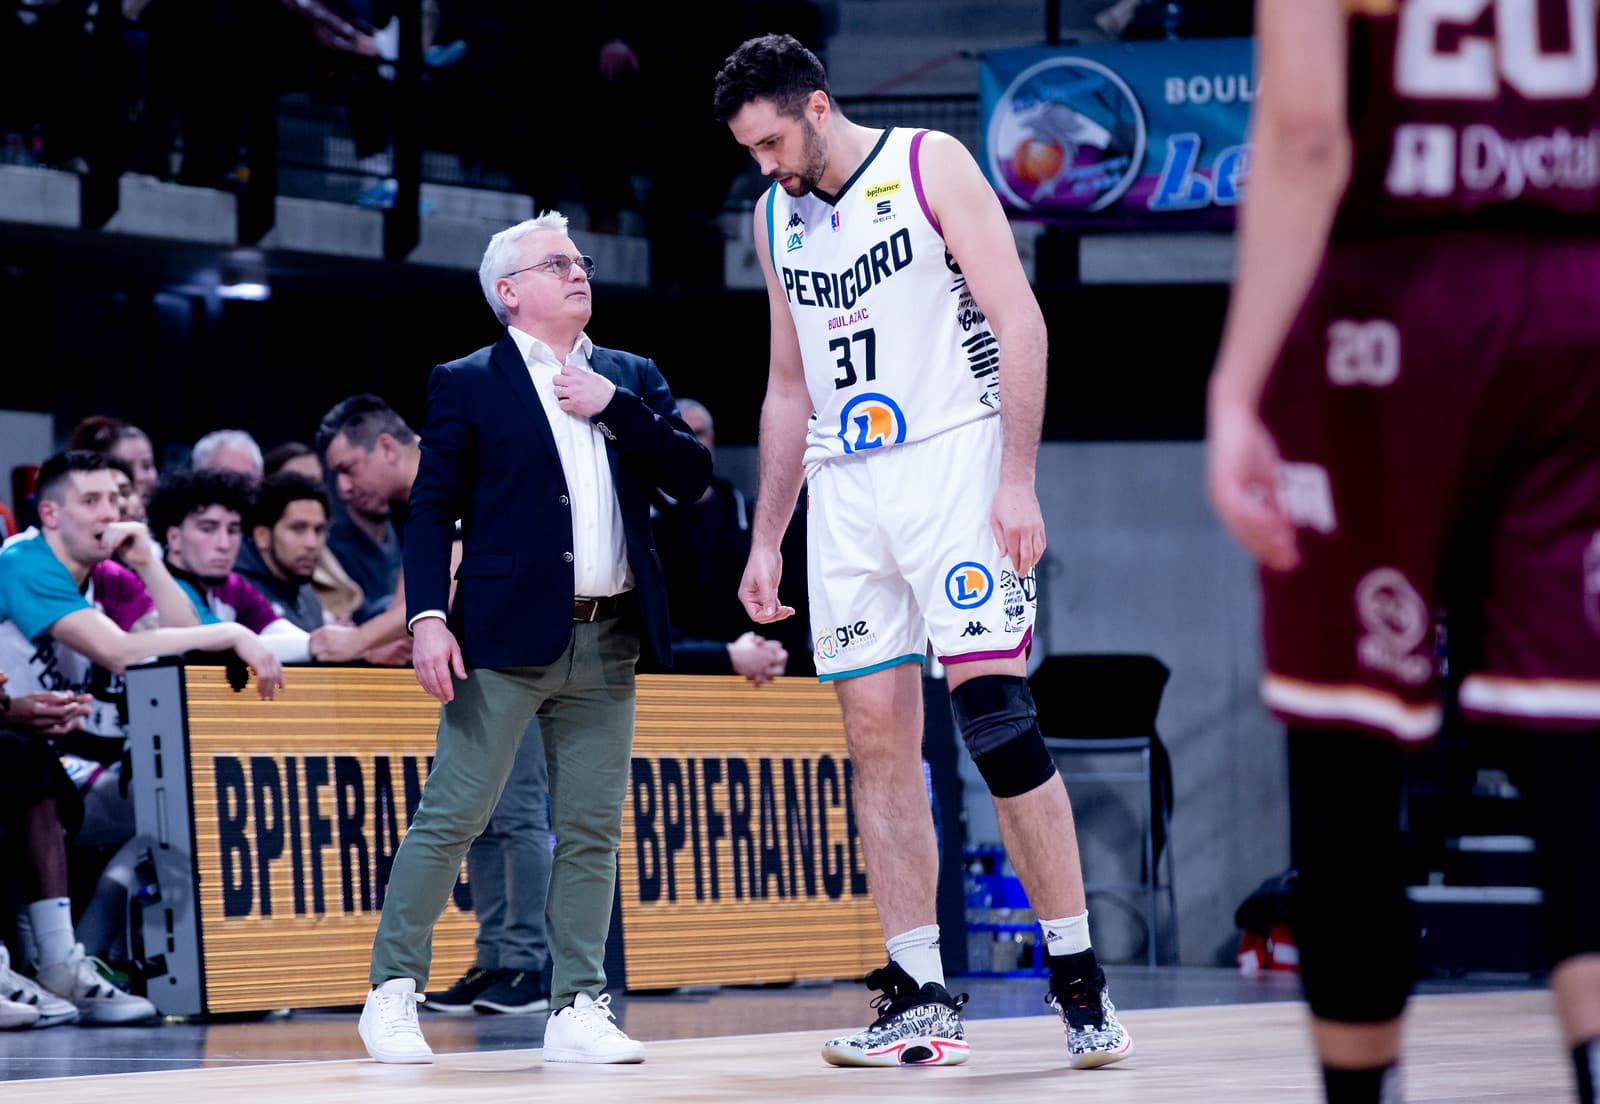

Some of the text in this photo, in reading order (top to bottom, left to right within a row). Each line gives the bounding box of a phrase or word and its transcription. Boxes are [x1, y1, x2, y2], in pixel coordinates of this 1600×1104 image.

[1165, 75, 1263, 104] BOUL
[872, 214, 897, 224] SEAT
[782, 227, 913, 310] PERIGORD
[828, 308, 869, 330] BOULAZAC
[828, 328, 876, 390] 37
[1327, 320, 1400, 387] 20
[836, 621, 869, 647] gie
[214, 756, 475, 917] BPIFRA
